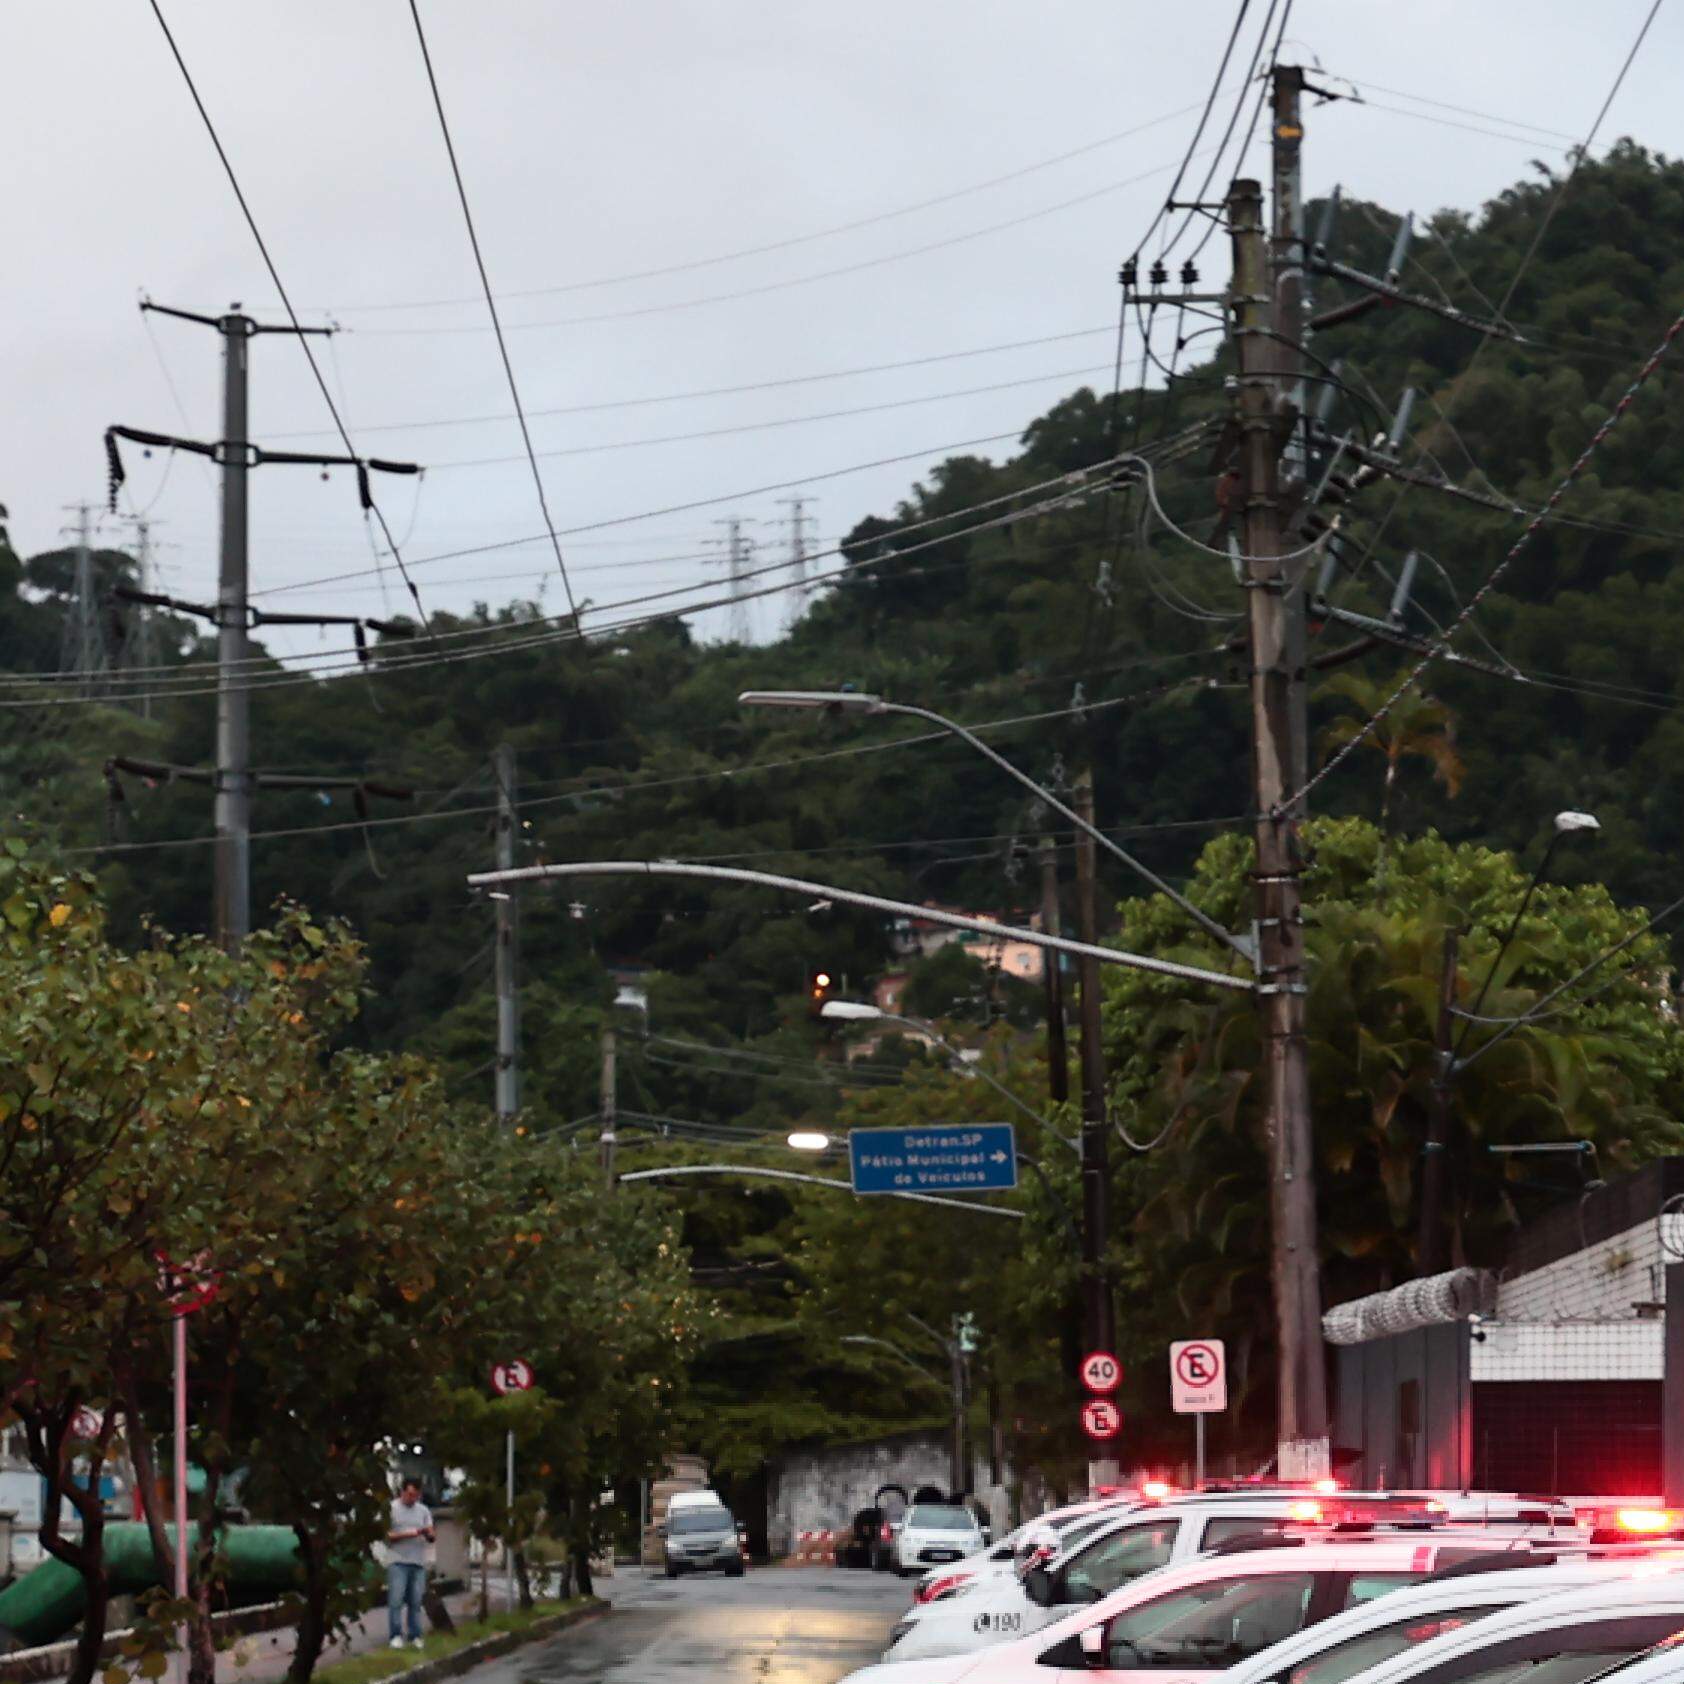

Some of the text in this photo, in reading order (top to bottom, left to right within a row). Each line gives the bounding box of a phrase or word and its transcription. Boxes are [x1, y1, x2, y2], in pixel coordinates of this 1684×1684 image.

[860, 1152, 985, 1168] Pátio Municipal
[893, 1173, 912, 1185] de
[1088, 1361, 1115, 1378] 40
